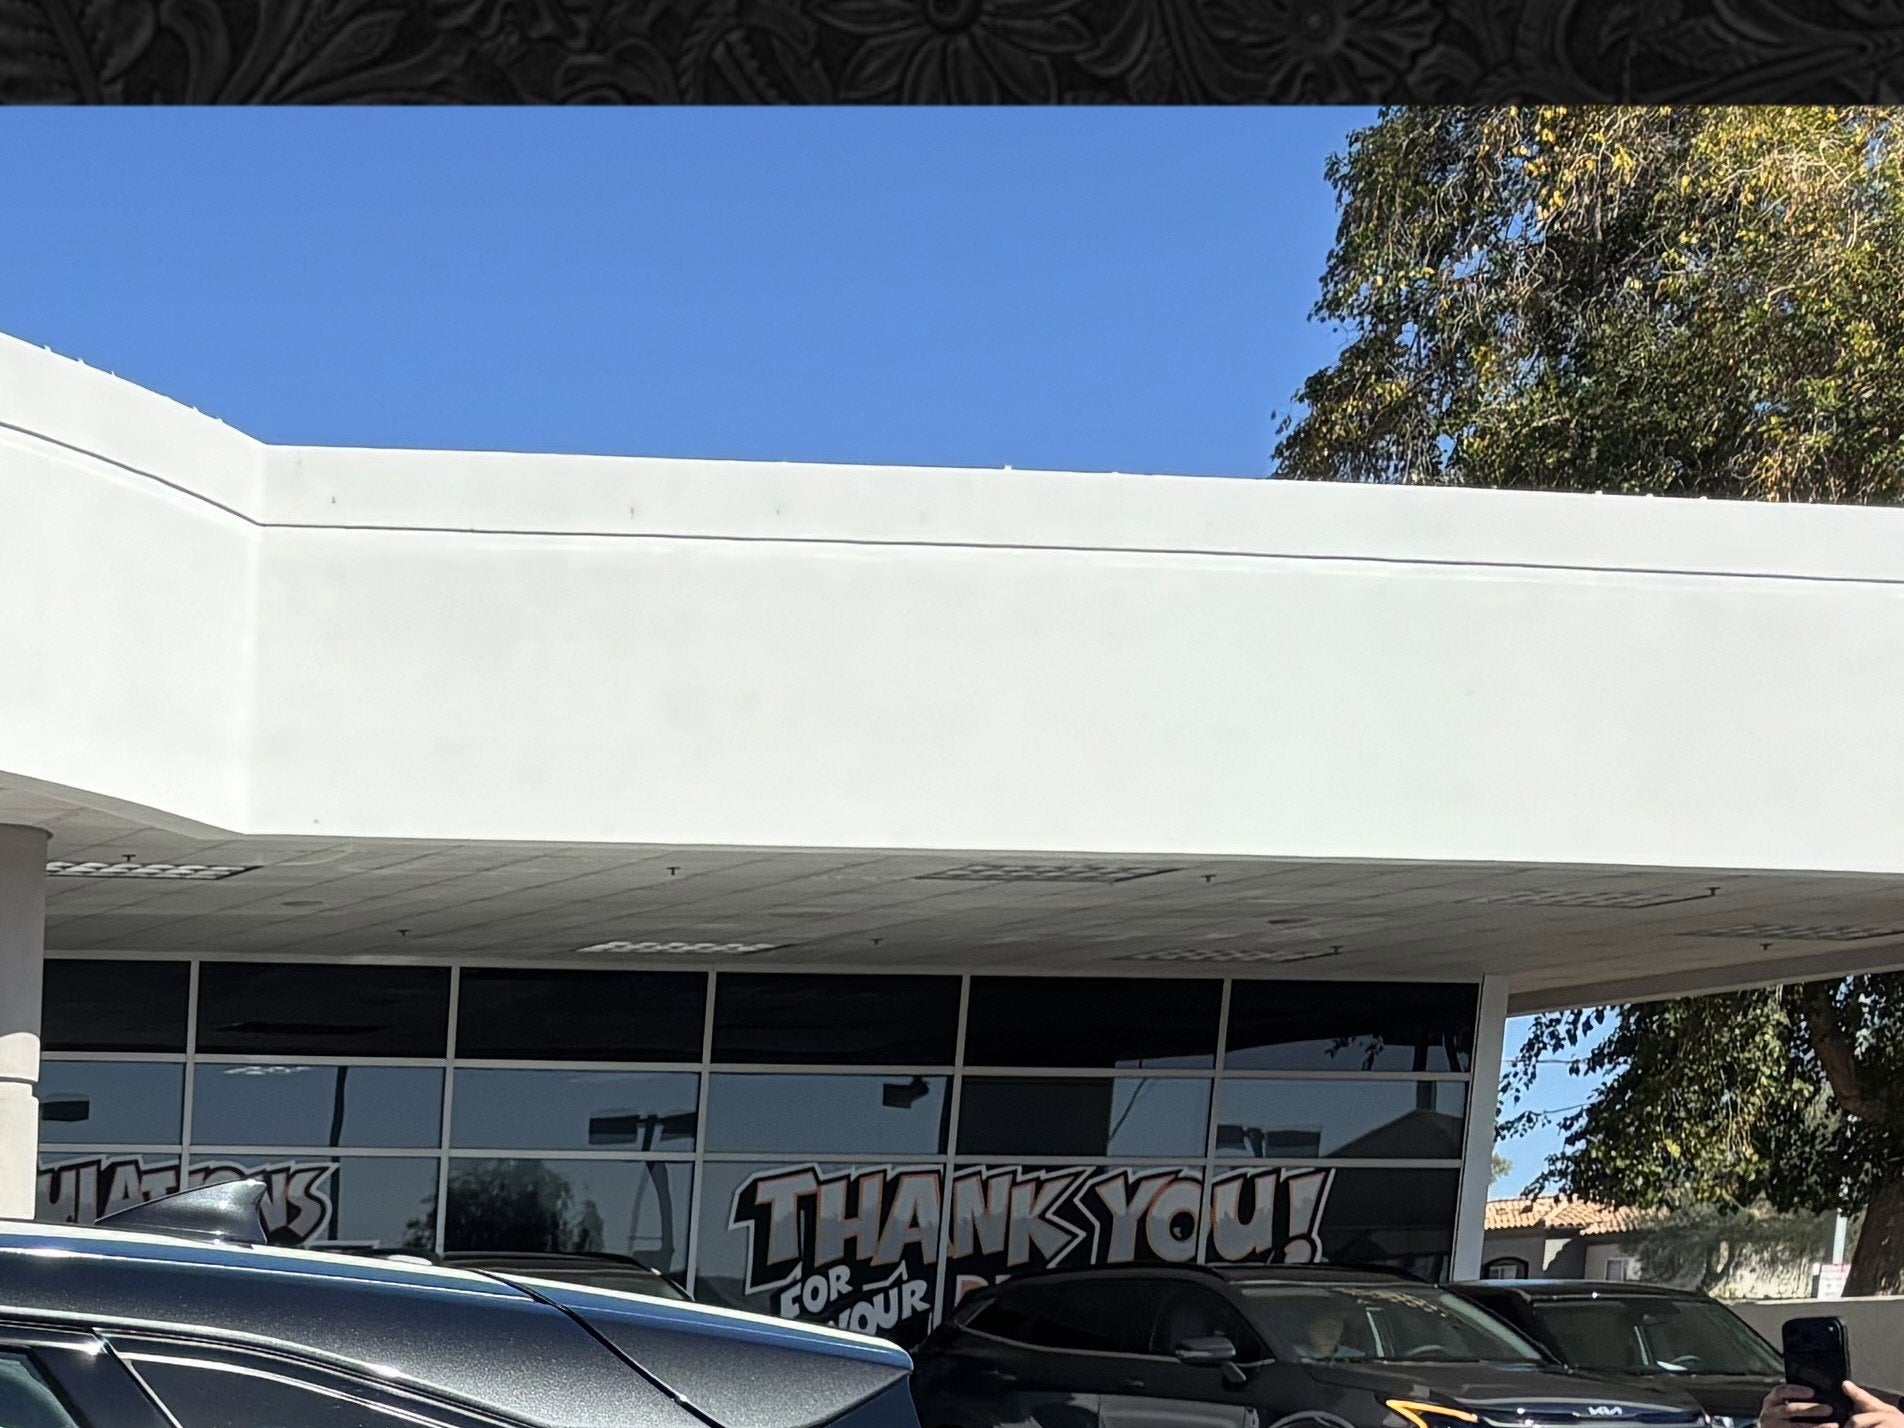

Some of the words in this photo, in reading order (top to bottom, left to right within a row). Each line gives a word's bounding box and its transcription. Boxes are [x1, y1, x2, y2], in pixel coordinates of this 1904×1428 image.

[744, 1167, 1080, 1272] THANK
[1092, 1168, 1334, 1266] YOU!
[780, 1265, 853, 1319] FOR
[826, 1280, 931, 1336] OUR
